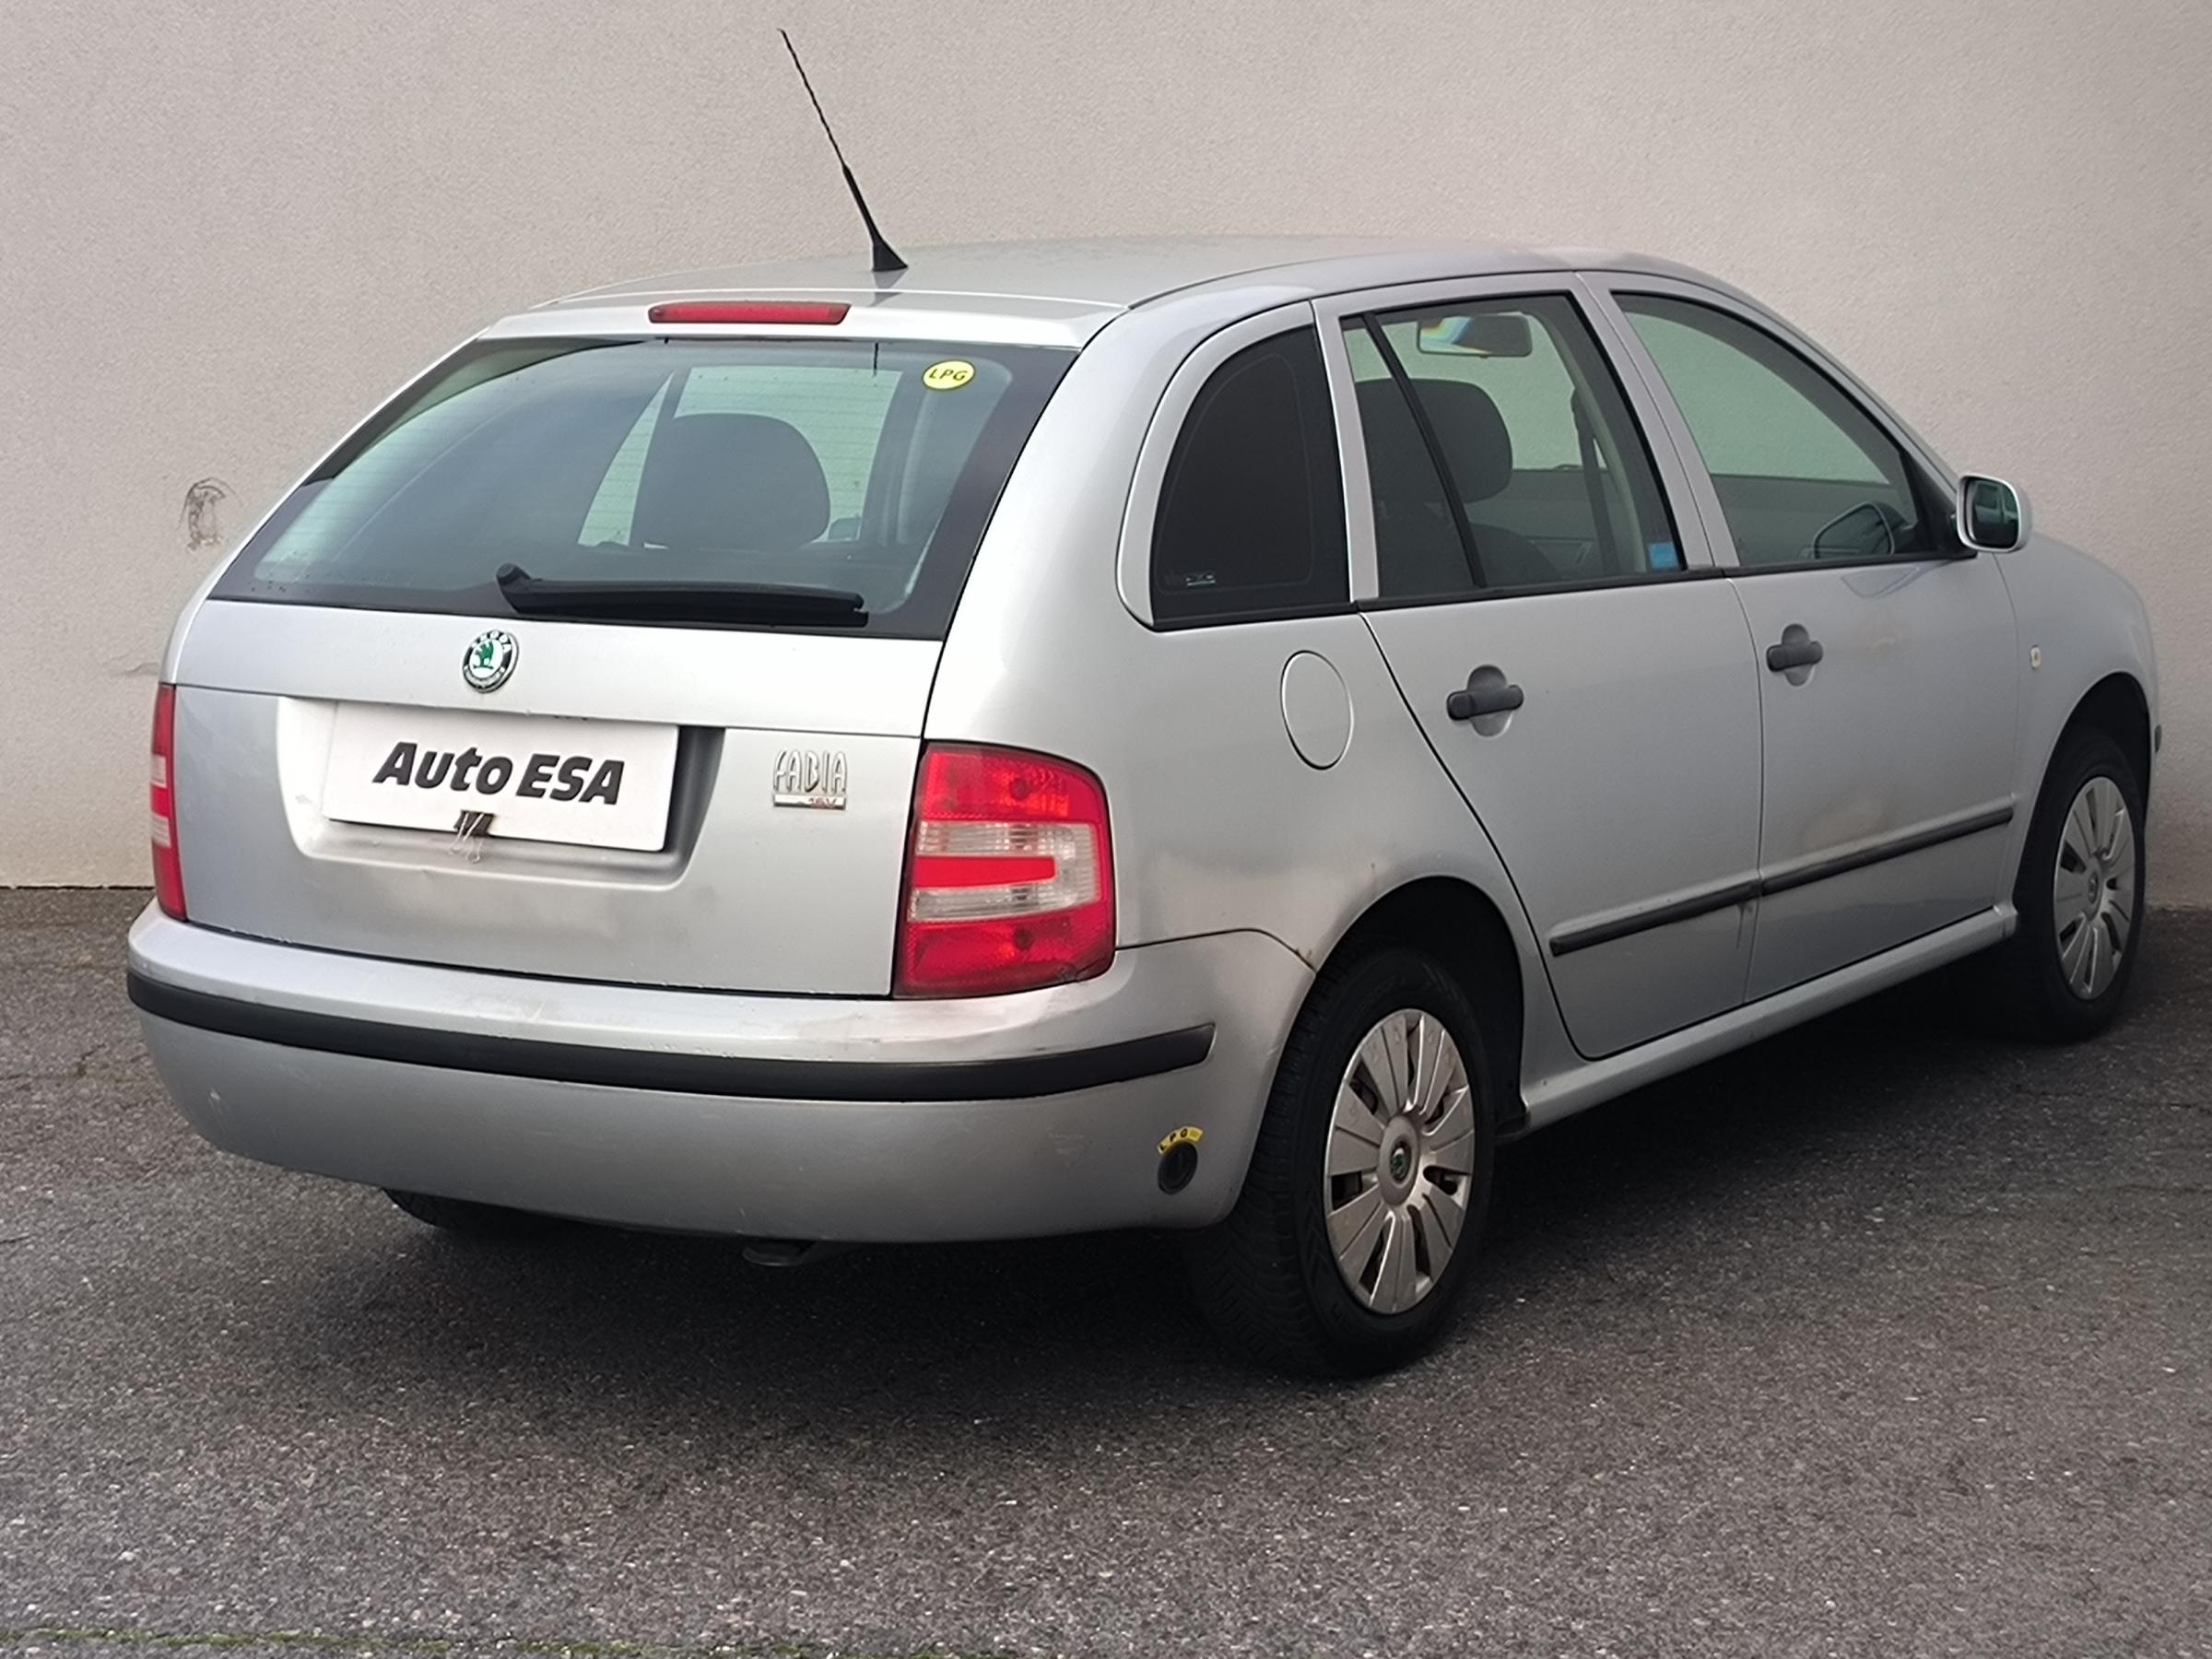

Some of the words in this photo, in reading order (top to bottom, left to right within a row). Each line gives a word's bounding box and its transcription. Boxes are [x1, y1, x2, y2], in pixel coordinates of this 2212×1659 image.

[928, 368, 969, 382] LPG
[372, 741, 513, 794] Auto
[515, 753, 625, 805] ESA
[773, 749, 847, 794] FABIA
